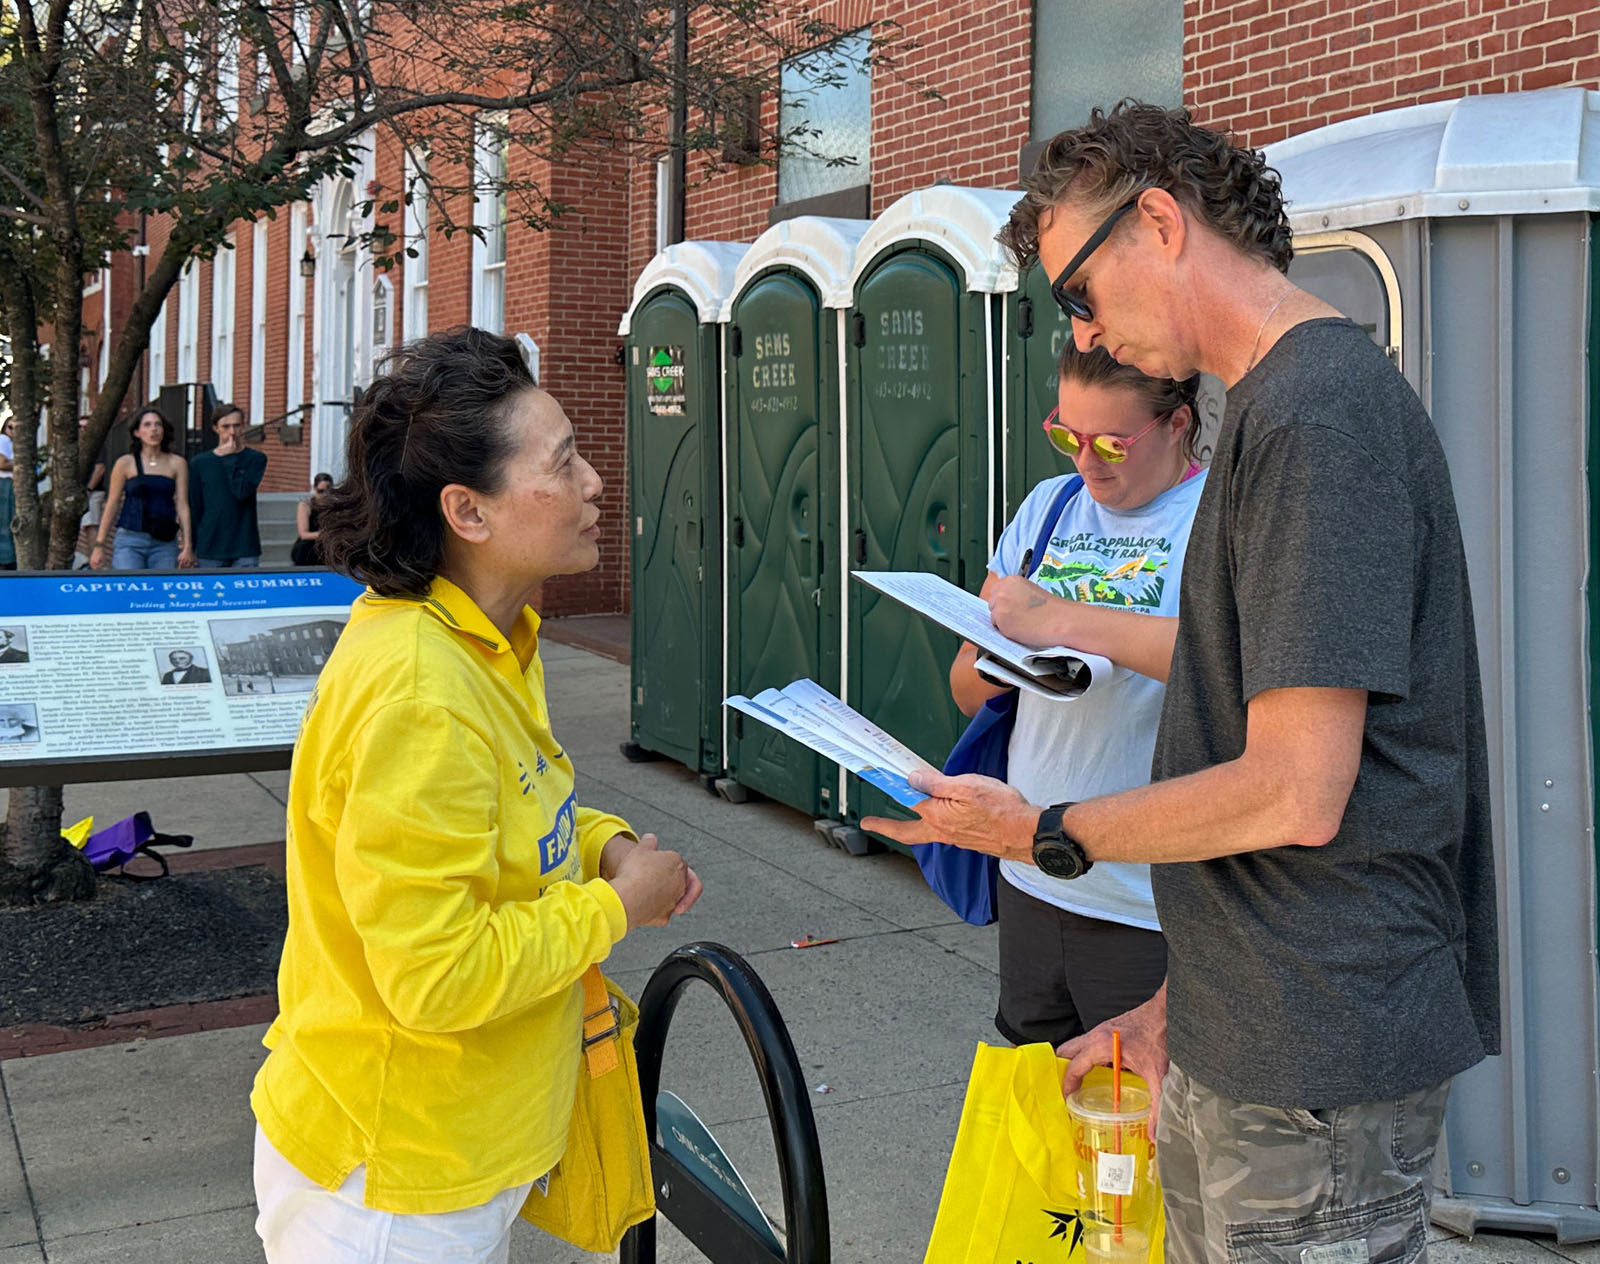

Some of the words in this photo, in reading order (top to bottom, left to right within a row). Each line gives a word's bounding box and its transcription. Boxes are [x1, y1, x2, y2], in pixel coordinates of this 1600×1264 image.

[880, 309, 924, 336] SAMS
[755, 333, 791, 360] SAMS
[877, 344, 930, 371] CREEK
[661, 365, 685, 377] CREEK
[752, 363, 796, 388] CREEK
[1069, 542, 1119, 559] VALLEY
[59, 582, 154, 593] CAPITAL
[162, 580, 204, 591] FOR
[212, 580, 226, 590] A
[233, 577, 324, 589] SUMMER
[169, 600, 219, 609] Maryland
[221, 599, 268, 607] Secession
